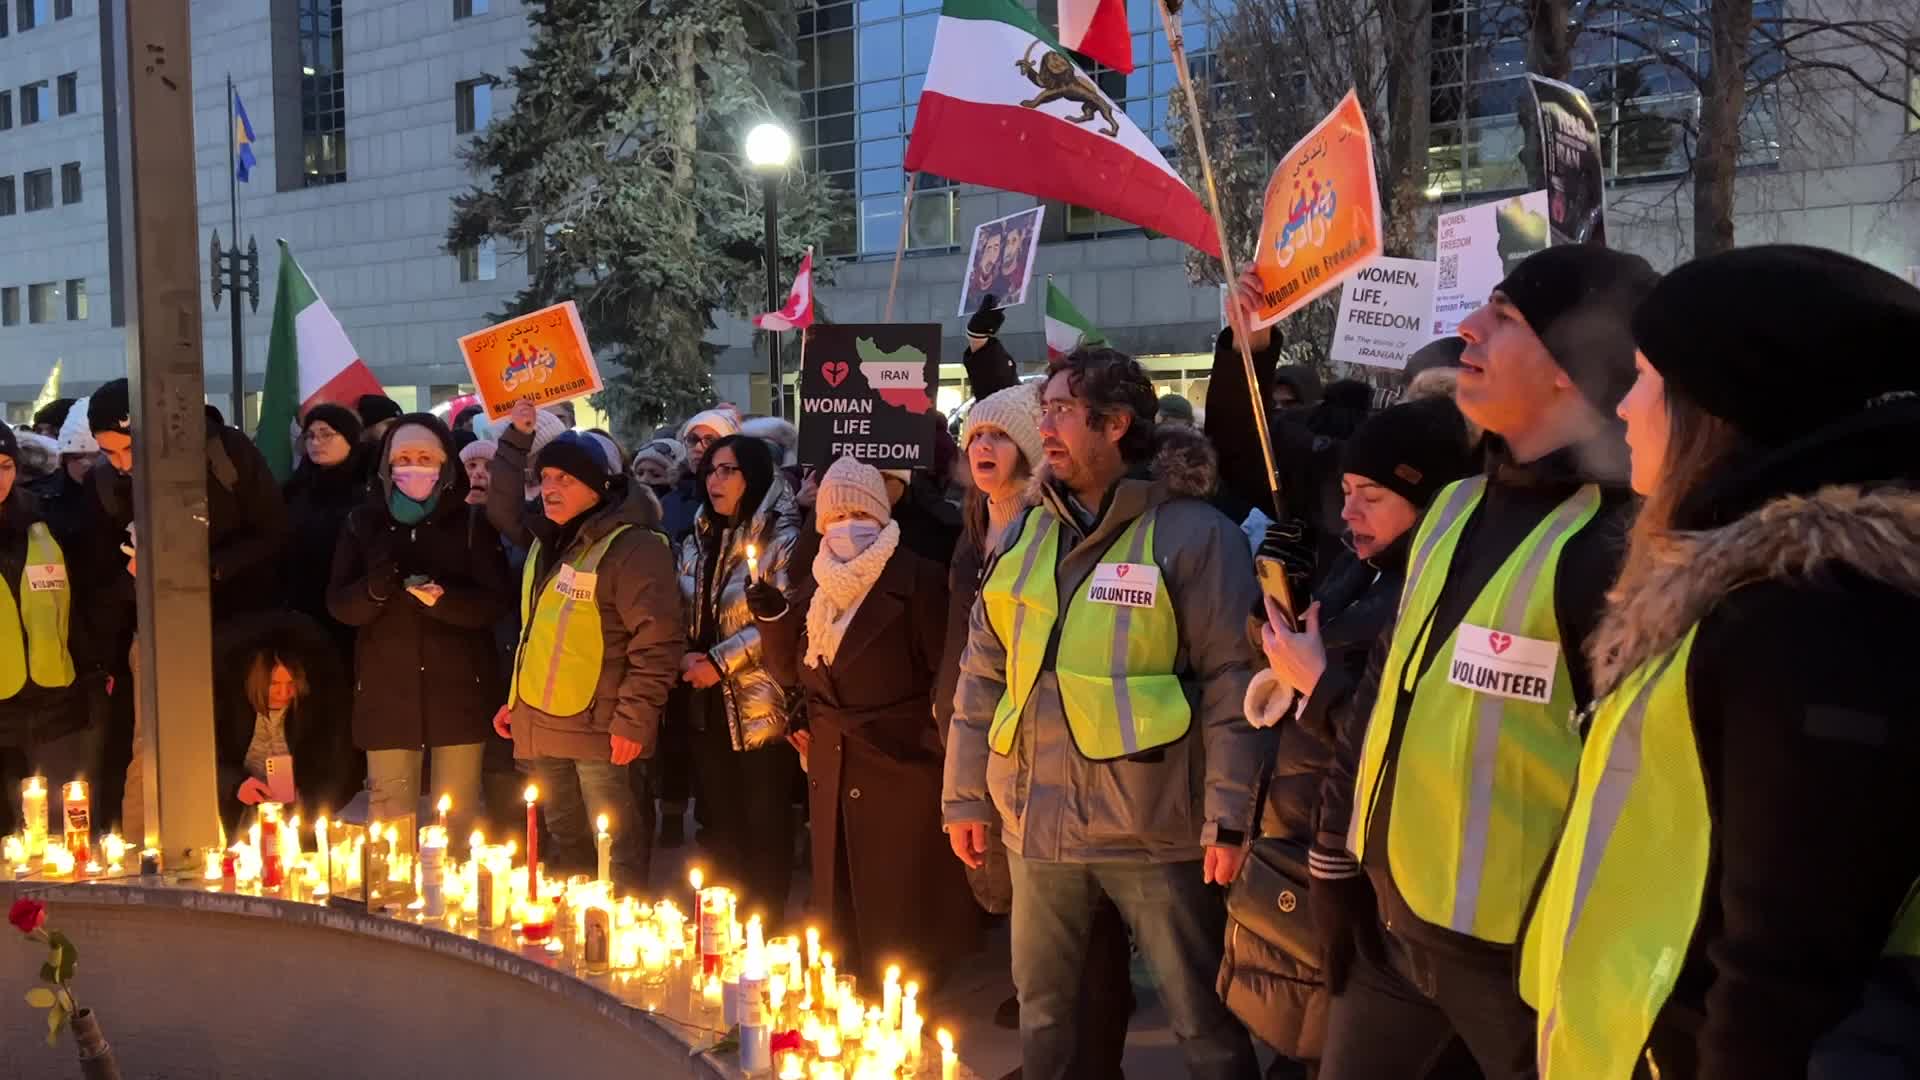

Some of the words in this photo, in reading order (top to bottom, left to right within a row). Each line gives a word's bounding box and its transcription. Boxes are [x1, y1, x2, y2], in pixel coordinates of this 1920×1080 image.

[1357, 267, 1420, 289] WOMEN,
[1265, 278, 1299, 308] Woman
[1348, 309, 1420, 331] FREEDOM
[1358, 347, 1404, 361] IRANIAN
[881, 370, 909, 381] IRAN
[804, 398, 873, 413] WOMAN
[833, 419, 871, 435] LIFE
[831, 443, 920, 460] FREEDOM
[1090, 586, 1152, 605] VOLUNTEER
[1452, 659, 1547, 699] VOLUNTEER
